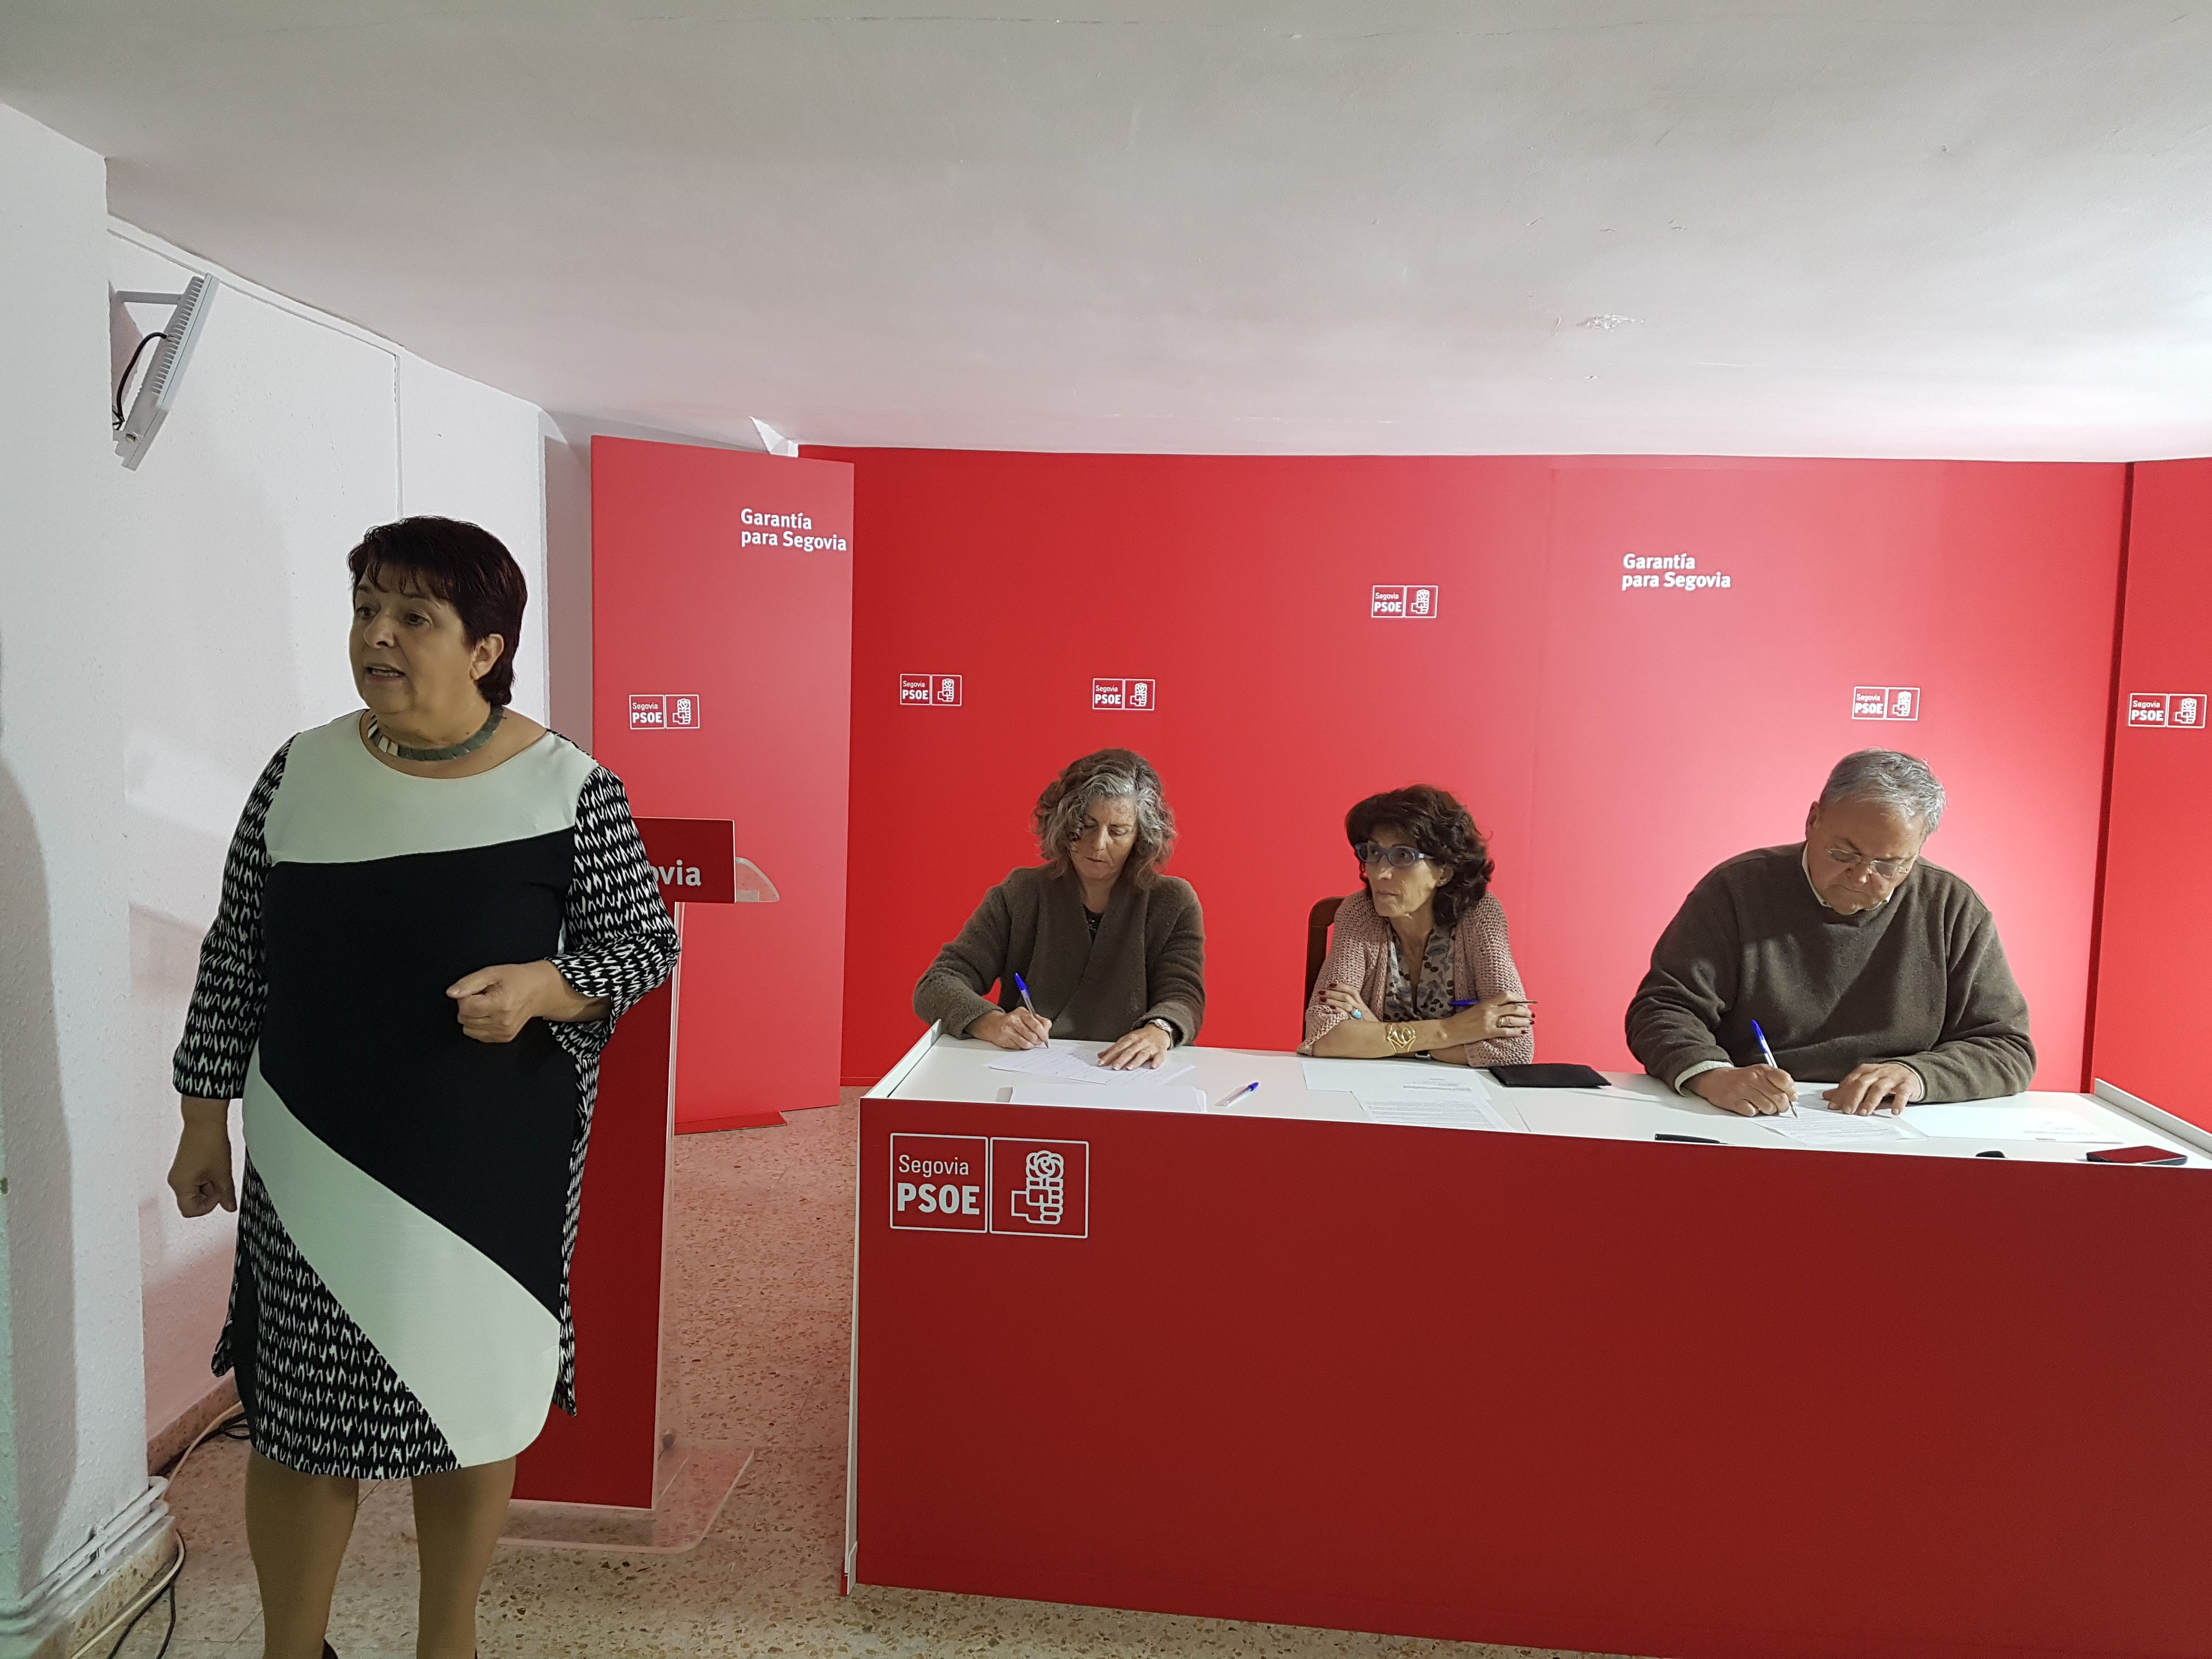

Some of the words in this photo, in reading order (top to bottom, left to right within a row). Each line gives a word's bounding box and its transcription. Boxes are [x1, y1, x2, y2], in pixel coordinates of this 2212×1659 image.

[741, 507, 812, 530] Garantía
[741, 531, 778, 547] para
[782, 531, 847, 552] Segovia
[1623, 552, 1695, 569] Garantía
[1622, 574, 1660, 591] para
[1663, 572, 1731, 591] Segovia
[1375, 592, 1400, 601] Segovia
[1374, 601, 1402, 612] PSOE
[902, 680, 926, 689] Segovia
[1095, 685, 1118, 693] Segovia
[902, 690, 928, 700] PSOE
[1095, 694, 1121, 704] PSOE
[1856, 693, 1881, 702] Segovia
[632, 702, 658, 712] Segovia
[1855, 703, 1883, 714] PSOE
[2132, 700, 2160, 709] Segovia
[632, 712, 662, 724] PSOE
[2131, 709, 2164, 721] PSOE
[899, 1154, 969, 1178] Segovia
[897, 1182, 980, 1215] PSOE
